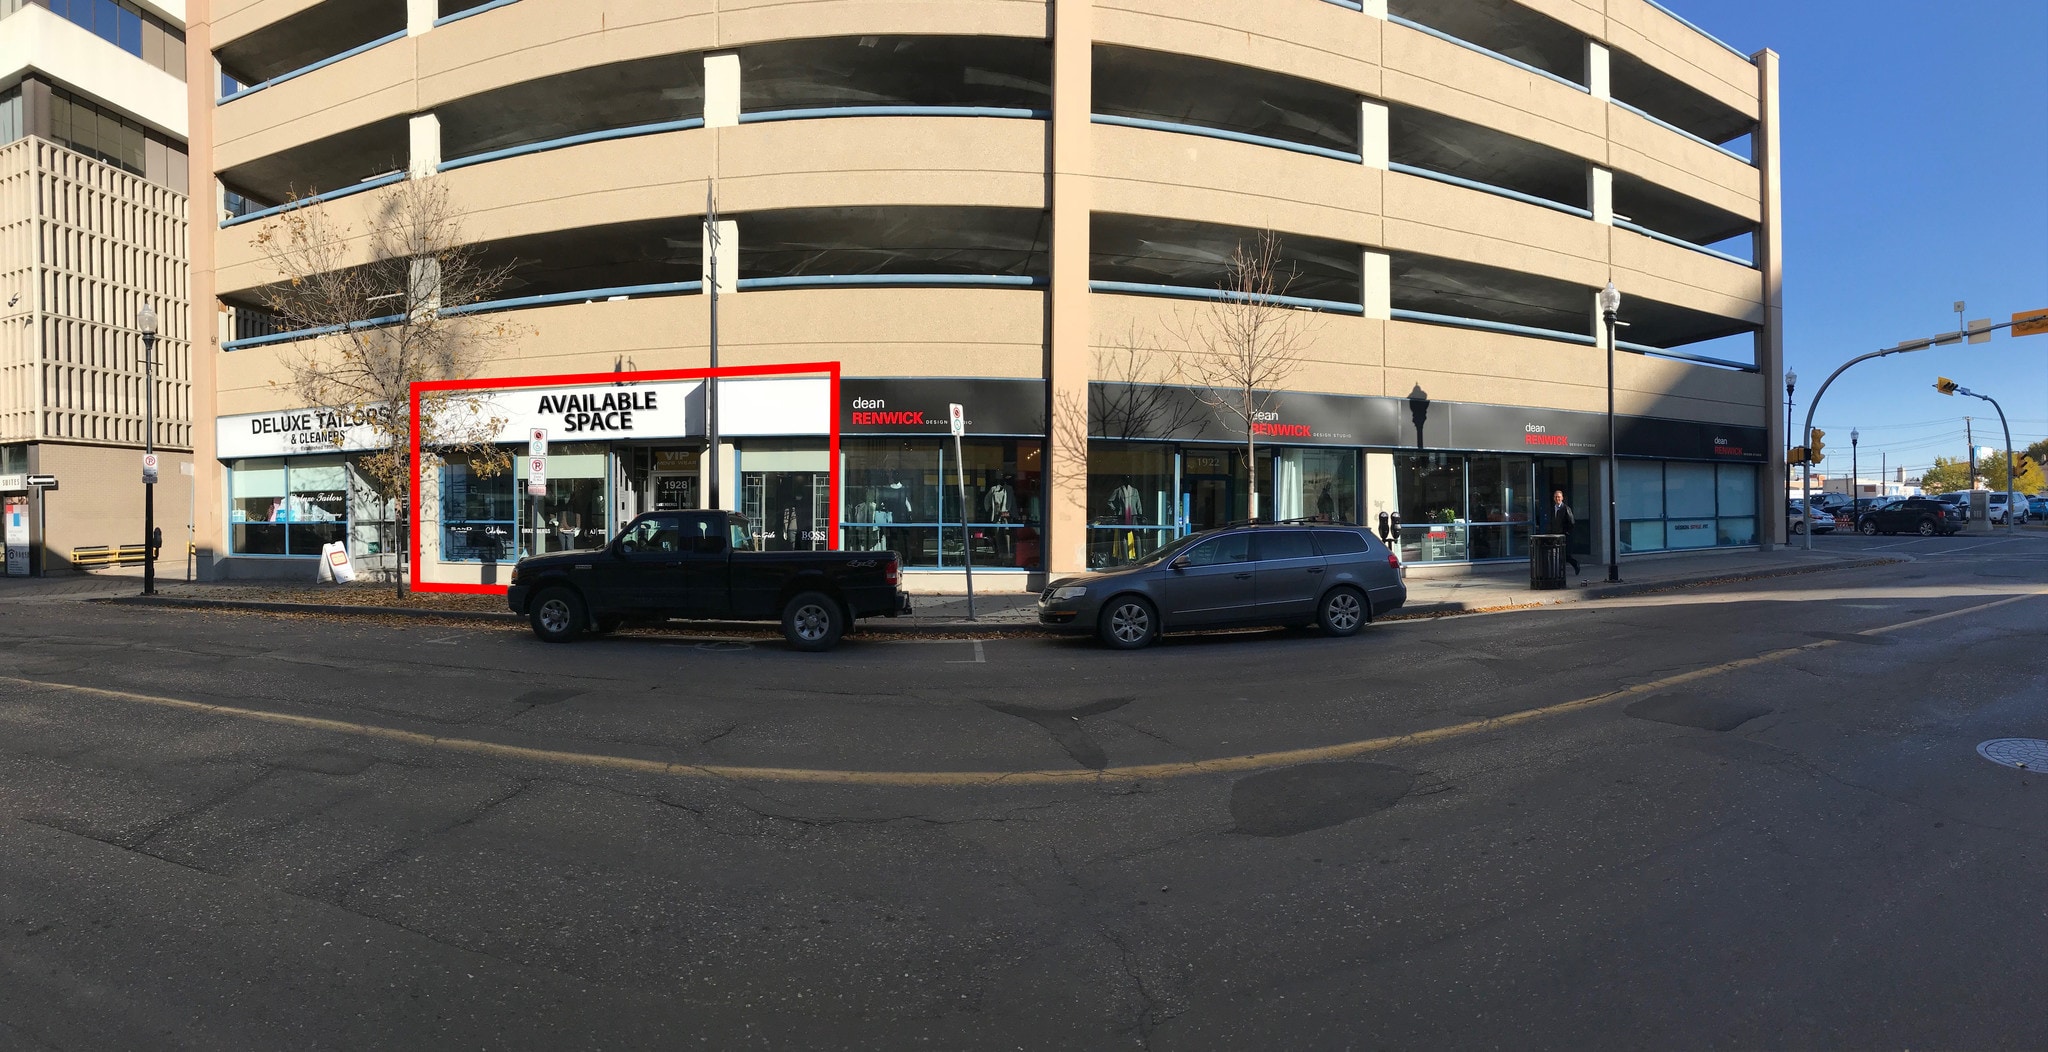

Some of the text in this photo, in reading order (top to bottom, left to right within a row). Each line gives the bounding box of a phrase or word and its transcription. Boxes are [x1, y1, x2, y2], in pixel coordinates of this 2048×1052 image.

[852, 397, 885, 408] dean
[852, 412, 923, 425] RENWICK
[1251, 409, 1279, 421] dean
[252, 414, 311, 434] DELUXE
[1525, 422, 1546, 433] dean
[1252, 423, 1311, 437] RENWICK
[290, 430, 345, 445] & CLEANERS
[1525, 434, 1568, 446] RENWICK
[1714, 436, 1728, 445] dean
[664, 451, 690, 460] VIP
[1714, 446, 1743, 456] RENWICK
[1197, 457, 1220, 467] 1922
[664, 480, 688, 489] 1928
[801, 530, 826, 539] BOSS
